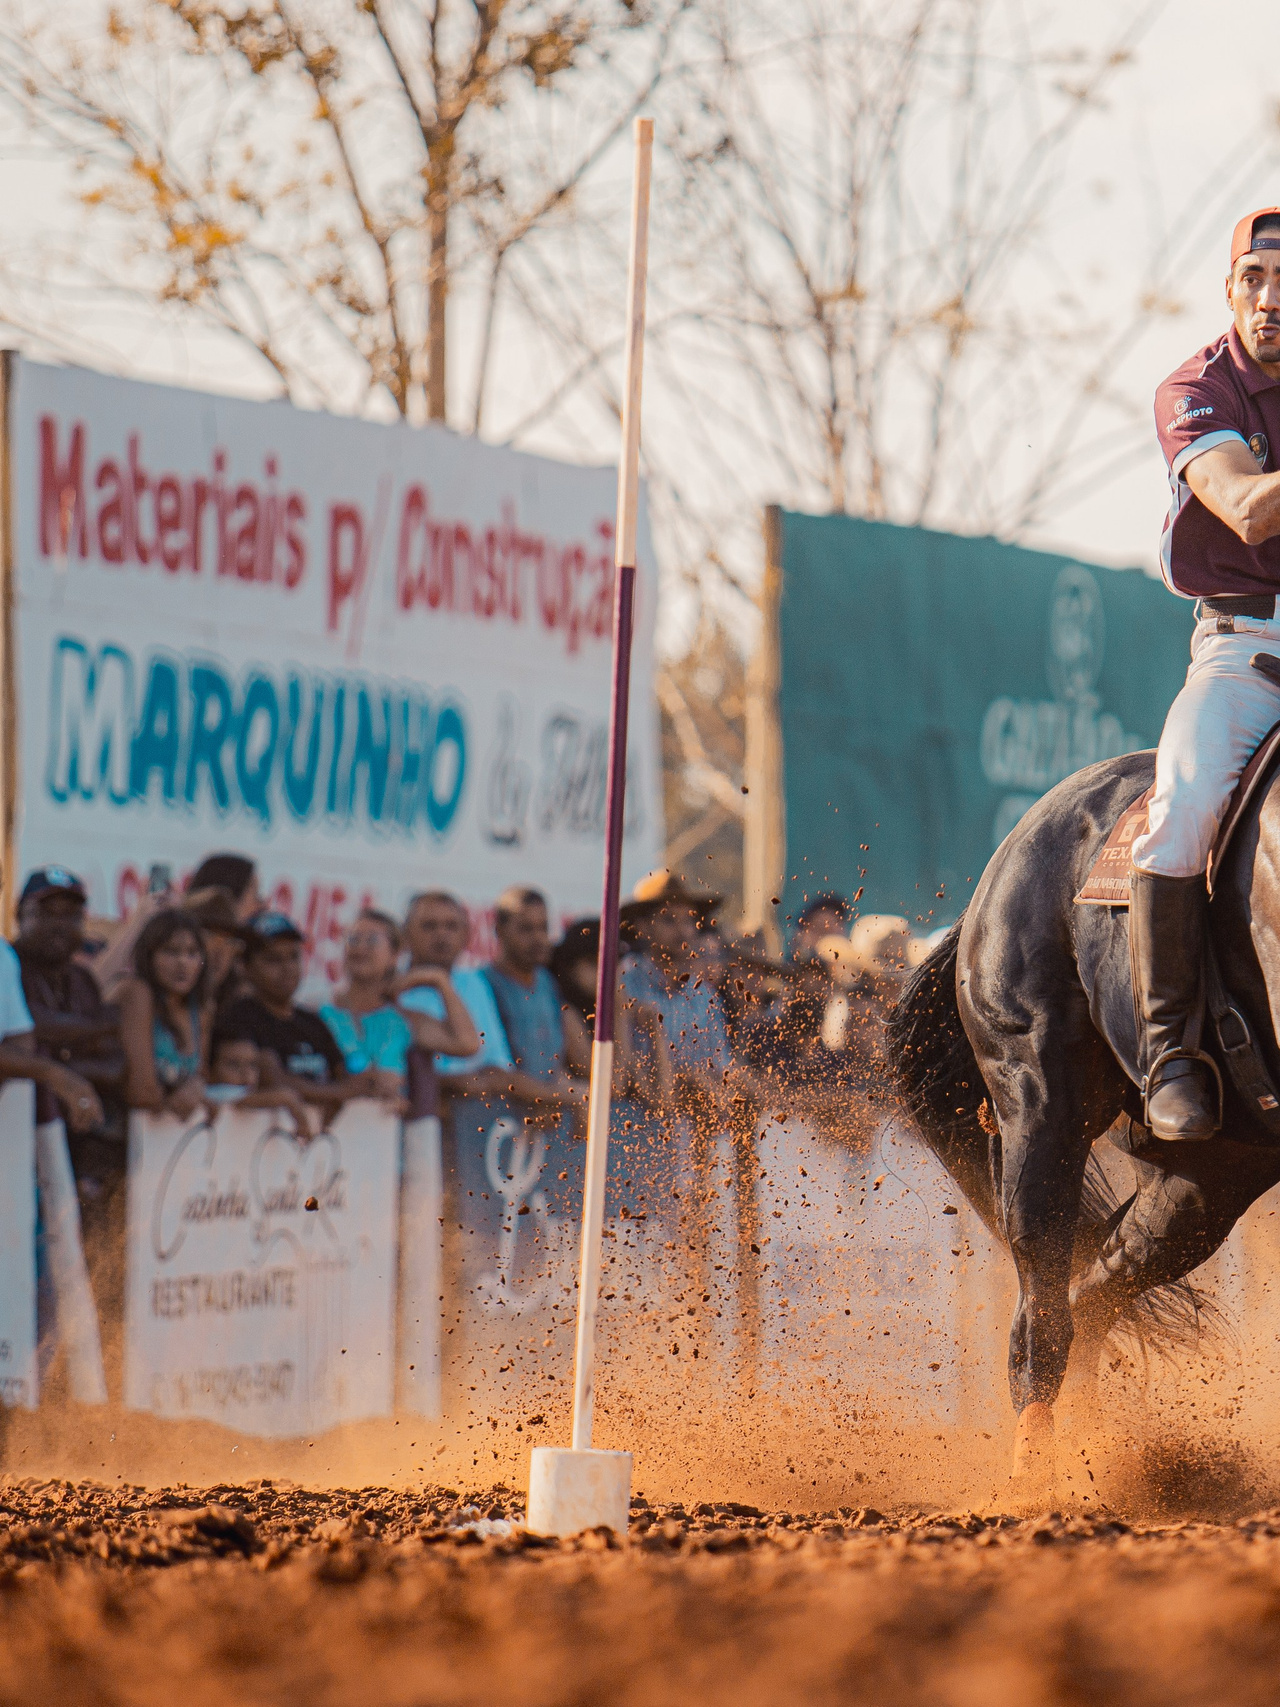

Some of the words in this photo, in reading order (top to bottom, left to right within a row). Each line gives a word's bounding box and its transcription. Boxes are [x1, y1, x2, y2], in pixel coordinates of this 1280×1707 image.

[1166, 406, 1214, 433] TELEPHOTO
[36, 410, 308, 592] Materiais
[395, 480, 640, 656] Construçã
[46, 634, 472, 846] MARQUINHO
